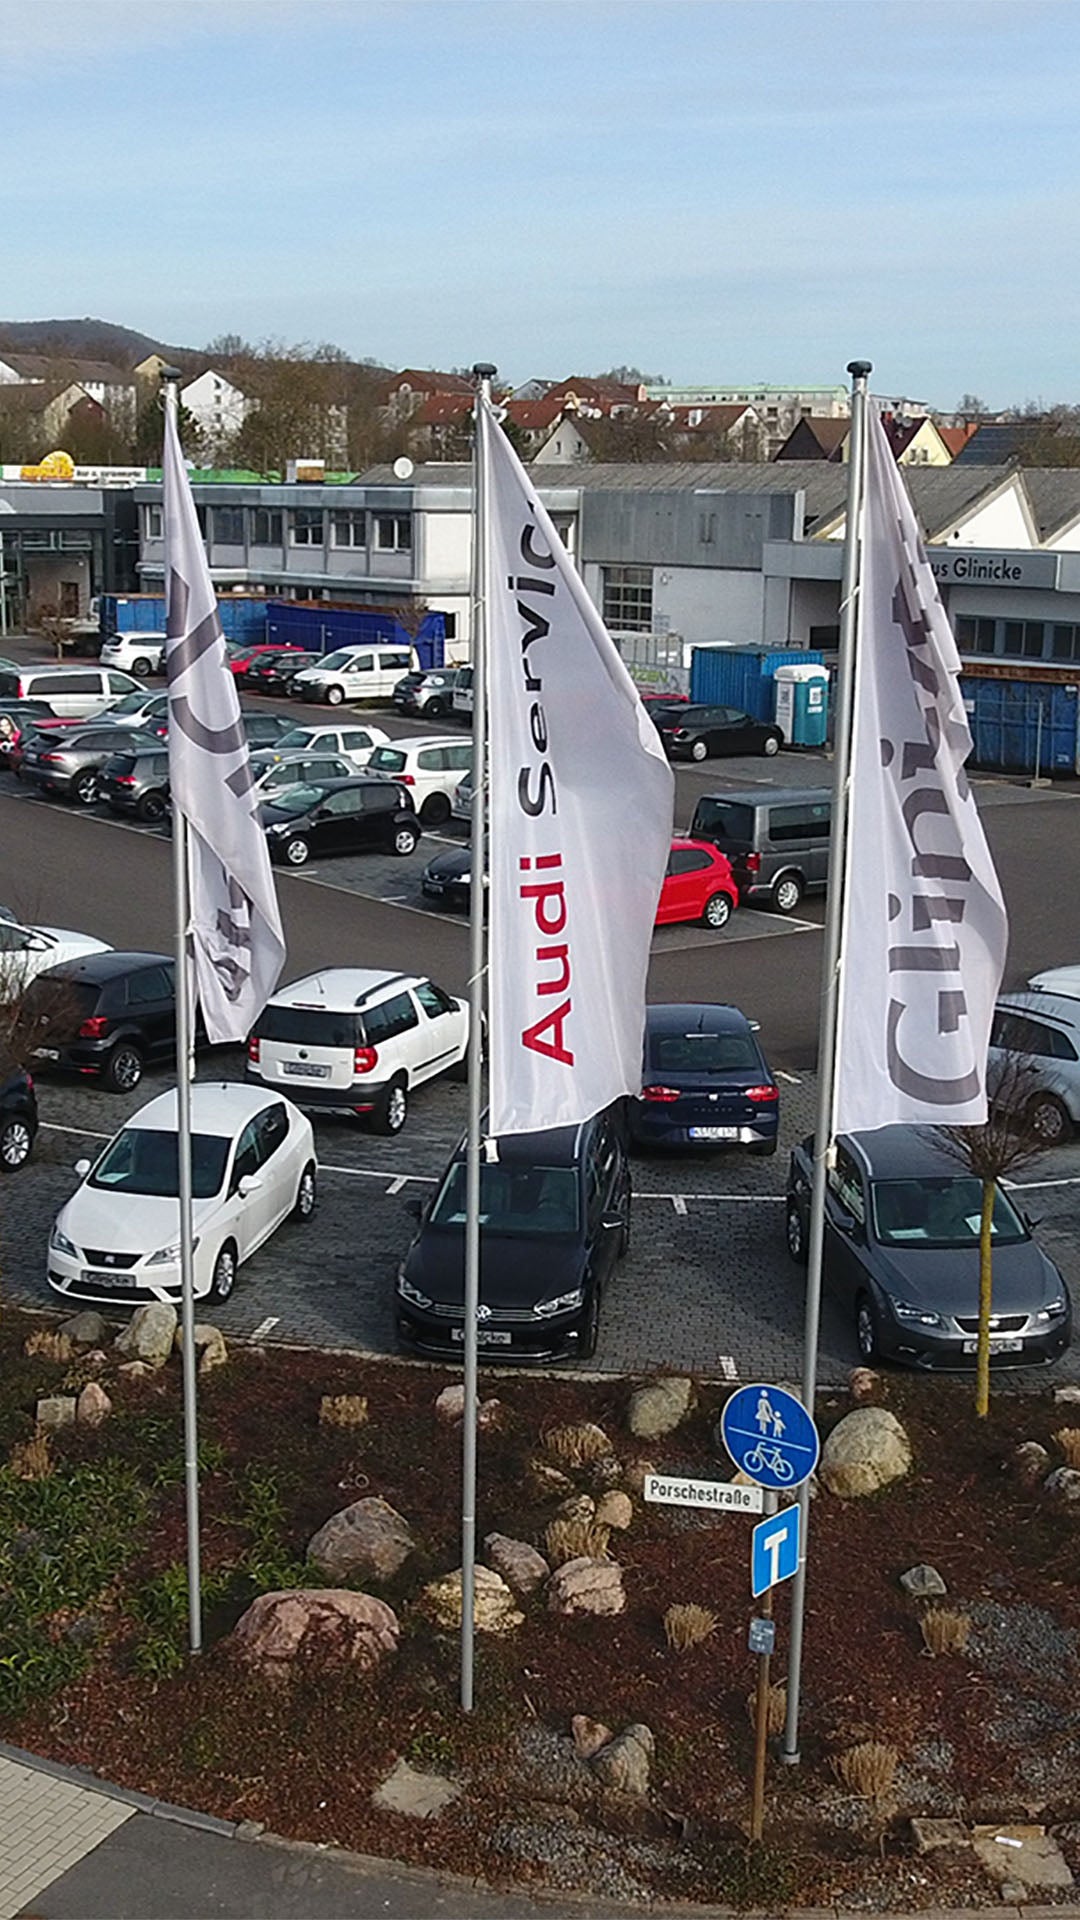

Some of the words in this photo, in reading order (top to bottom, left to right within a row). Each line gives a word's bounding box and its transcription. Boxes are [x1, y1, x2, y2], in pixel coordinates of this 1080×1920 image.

[953, 557, 1022, 580] Glinicke
[507, 500, 558, 818] Servic
[519, 853, 574, 1067] Audi
[649, 1479, 751, 1506] Porschestraße
